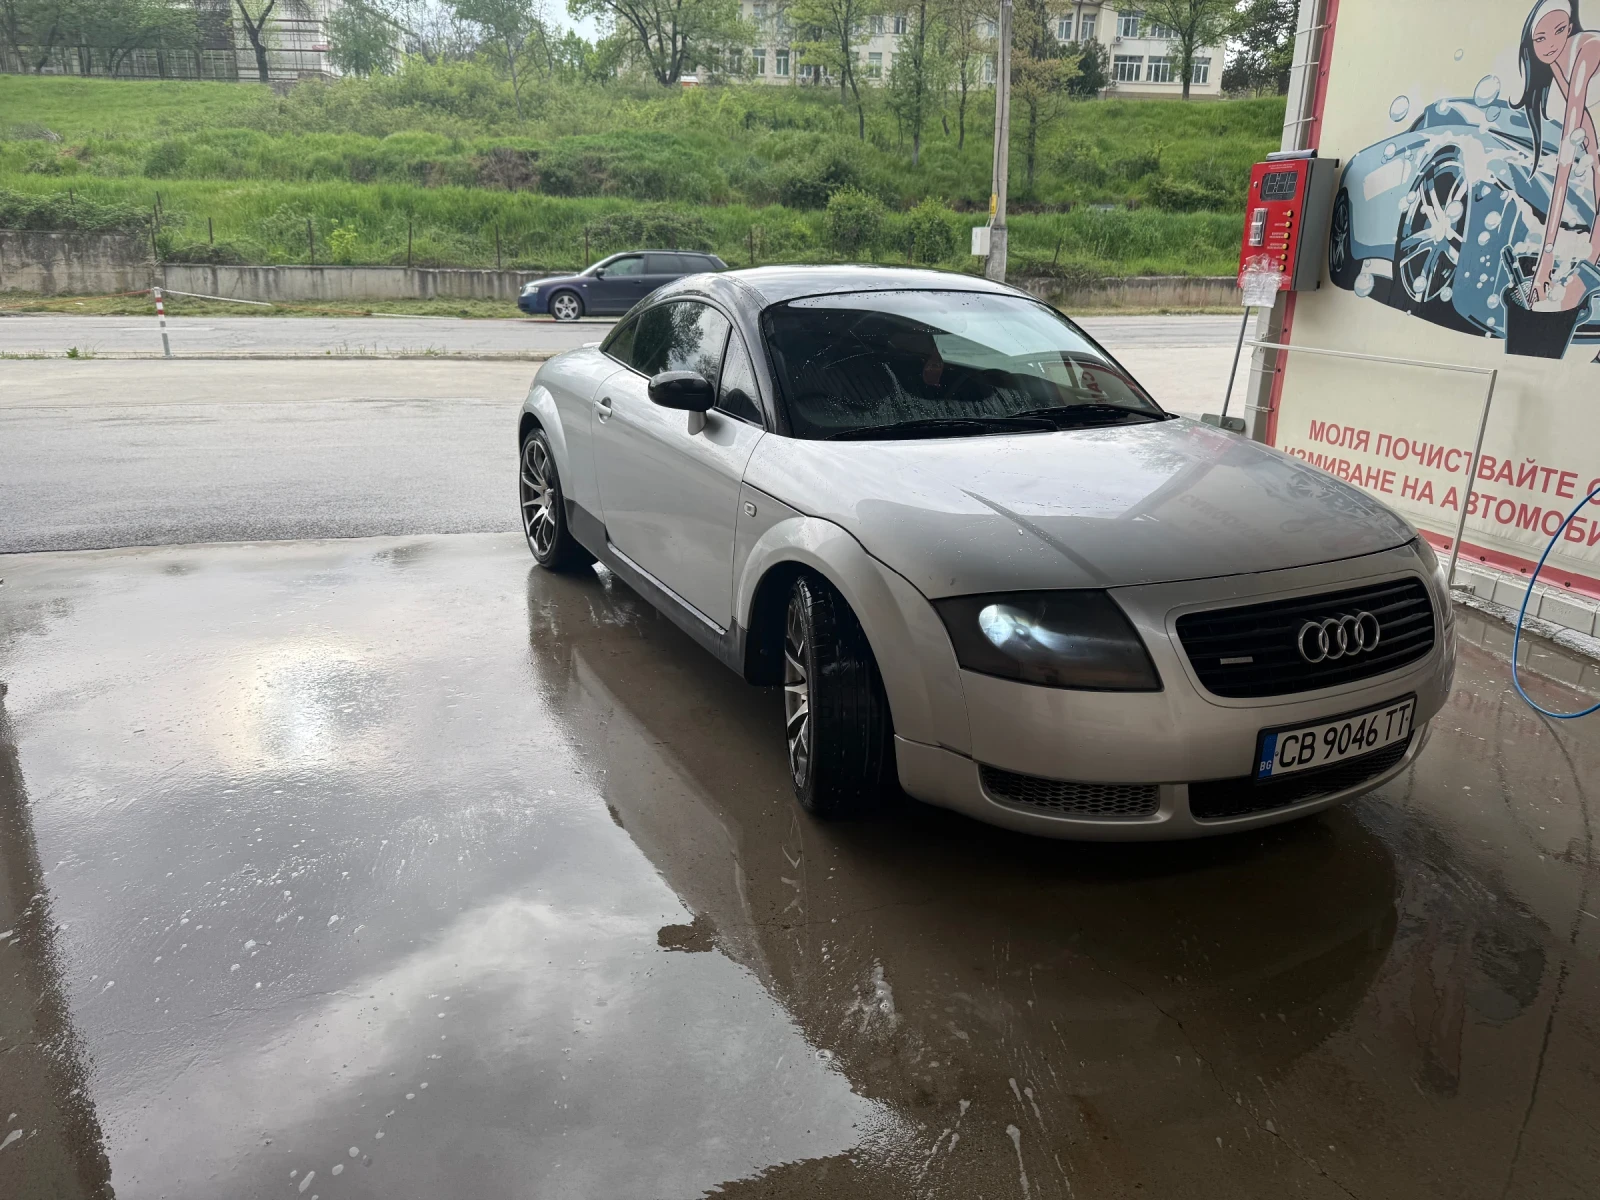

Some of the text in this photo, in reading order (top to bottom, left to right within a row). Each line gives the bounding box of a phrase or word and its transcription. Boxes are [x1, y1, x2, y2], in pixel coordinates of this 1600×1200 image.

[1309, 419, 1370, 453] МОЛЯ
[1375, 433, 1578, 499] ПОЧИСТВАЙТЕ
[1400, 475, 1434, 505] НА
[1279, 703, 1411, 768] CB 9046 TT
[1260, 760, 1272, 771] BG
